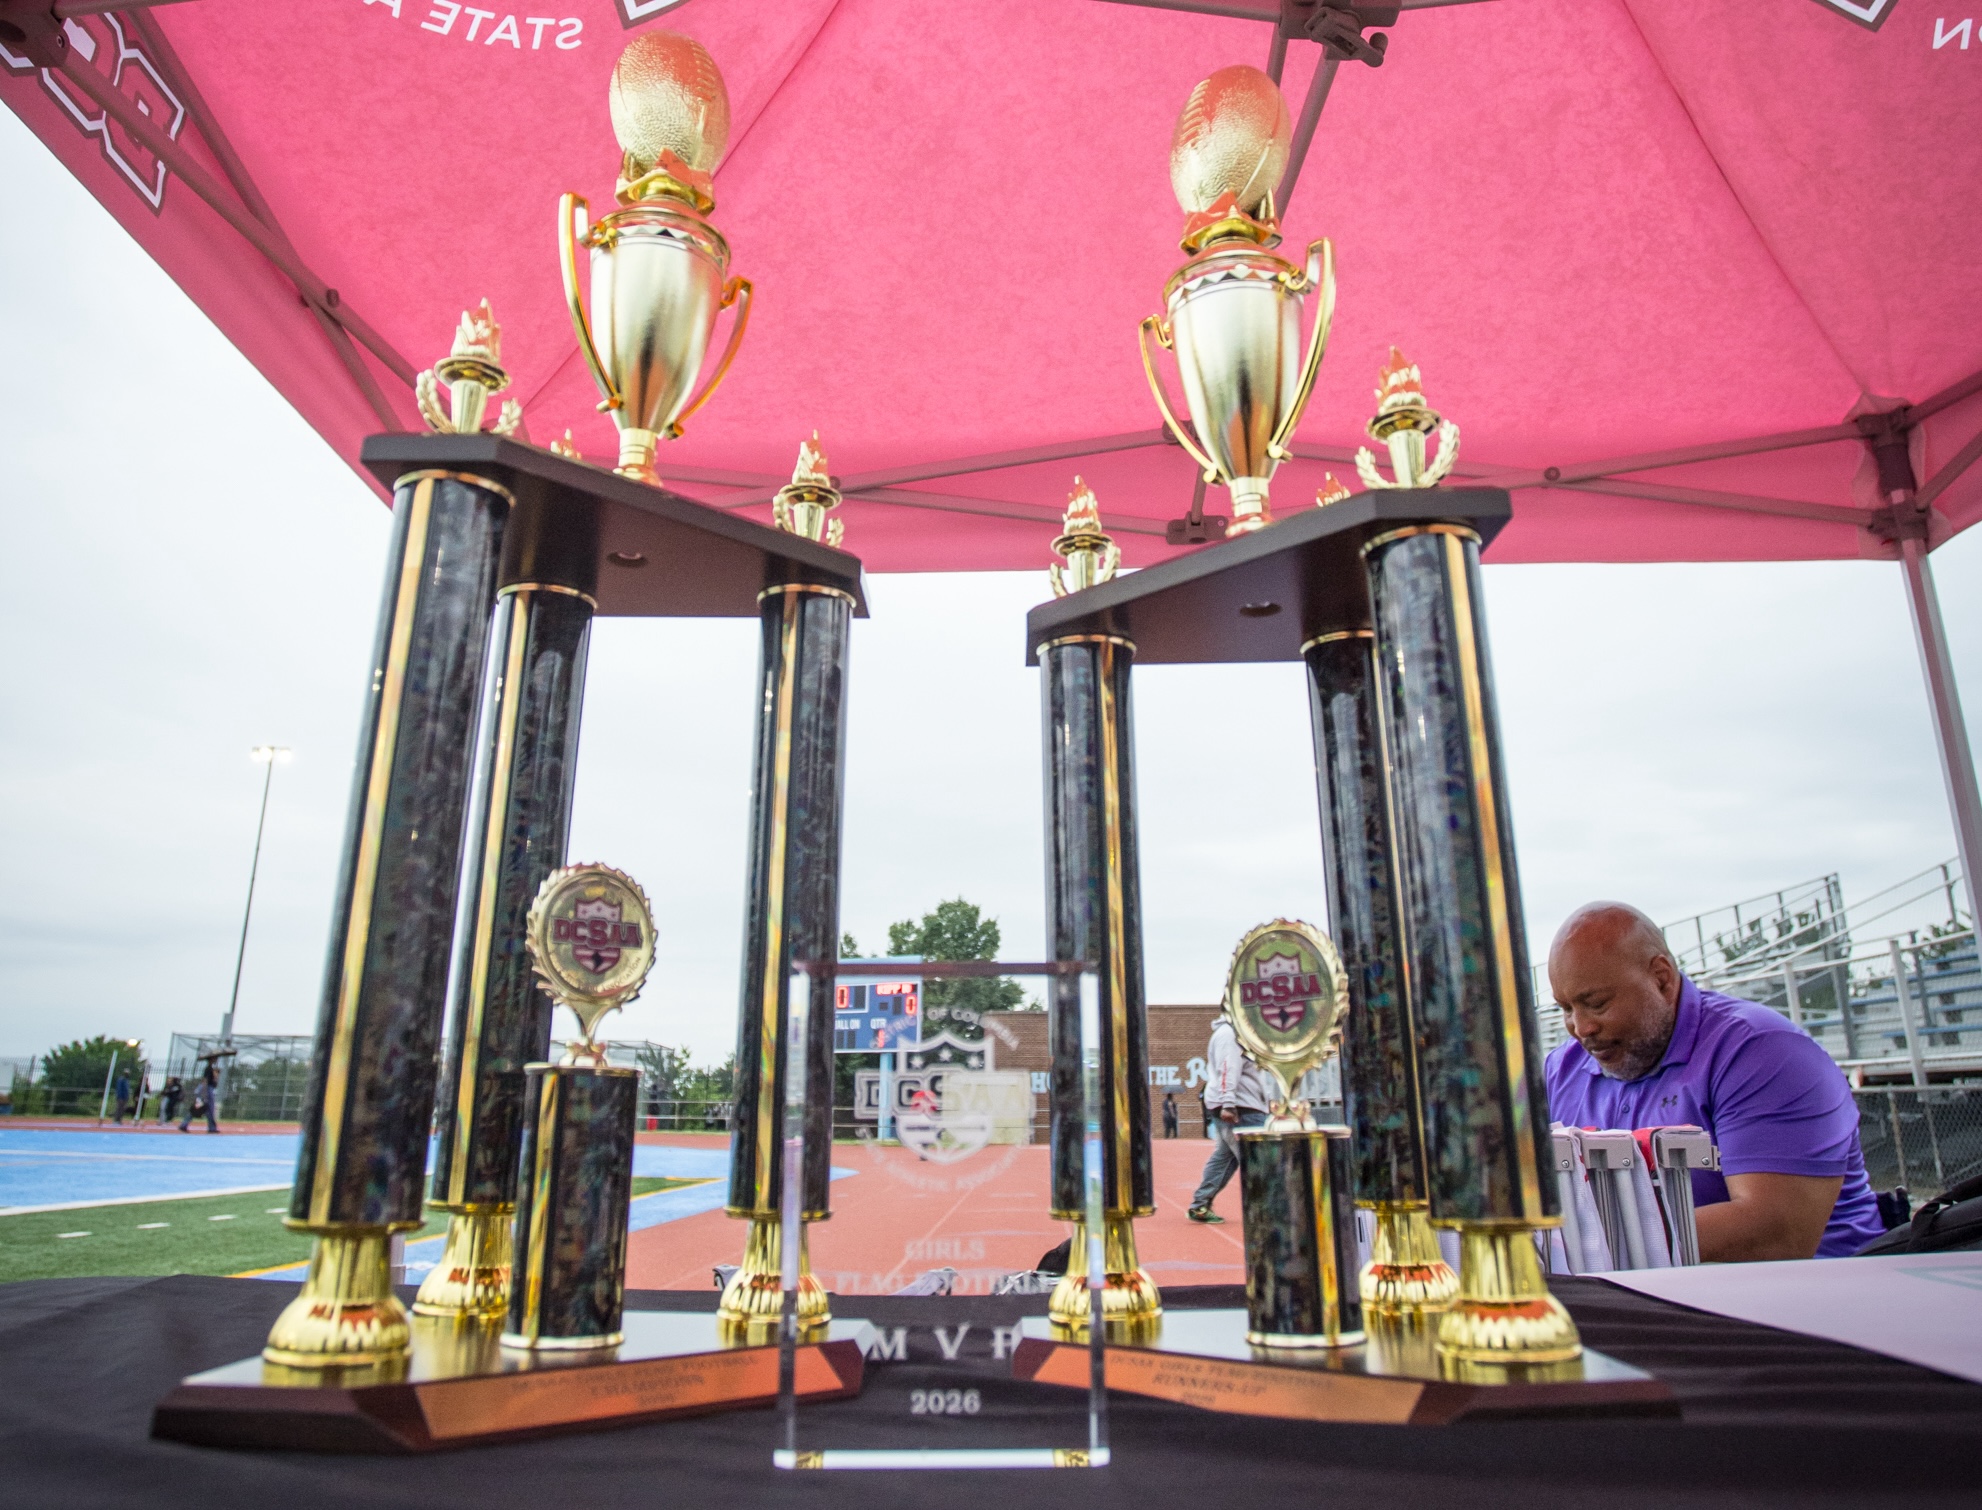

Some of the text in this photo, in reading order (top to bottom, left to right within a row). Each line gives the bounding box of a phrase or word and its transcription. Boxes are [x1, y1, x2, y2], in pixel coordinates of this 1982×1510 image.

[552, 917, 643, 948] DCSAA
[1241, 973, 1323, 1006] DCSAA
[906, 994, 918, 1016] 0
[906, 1240, 985, 1261] GIRLS
[910, 1388, 981, 1414] 2026
